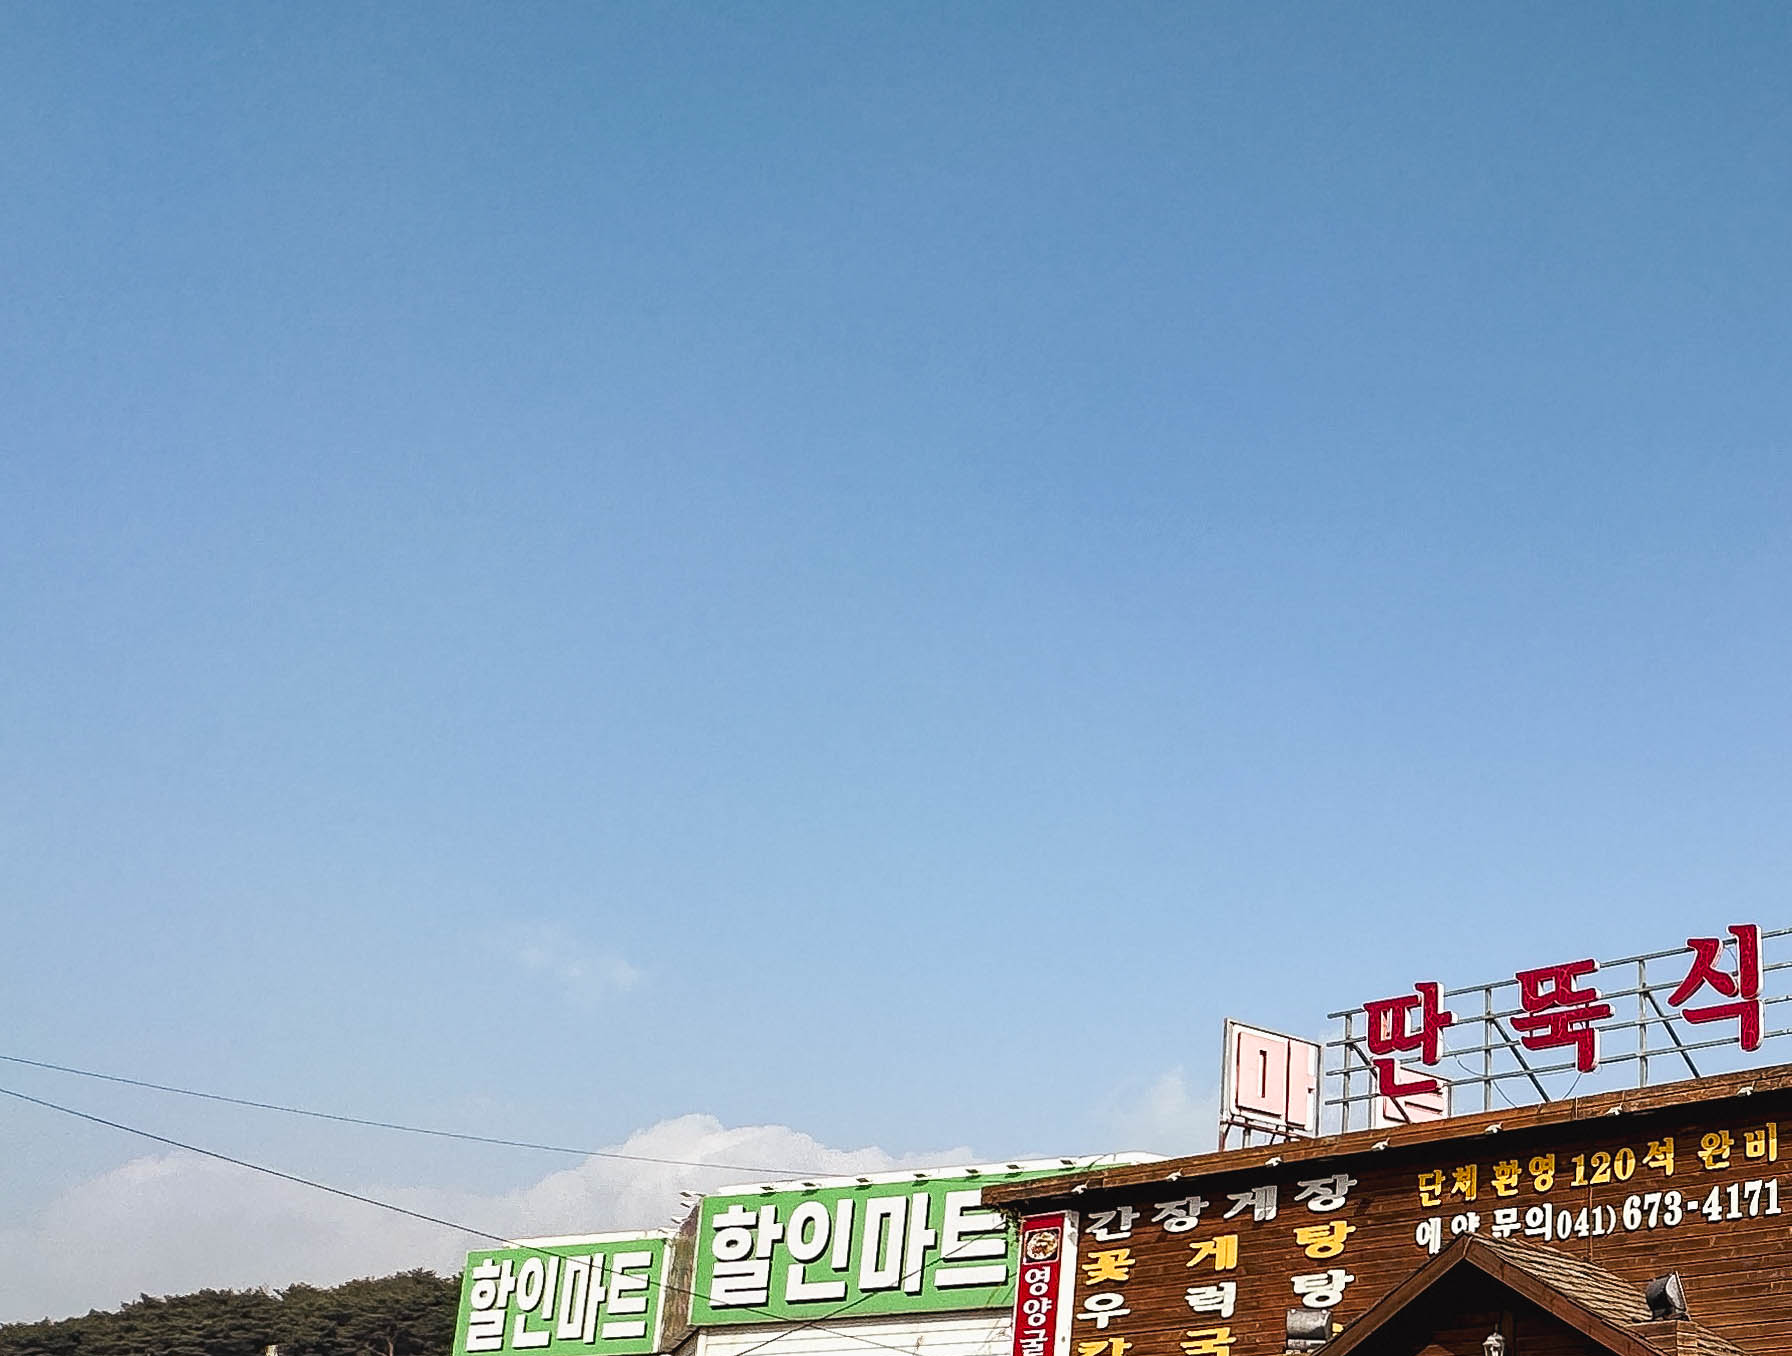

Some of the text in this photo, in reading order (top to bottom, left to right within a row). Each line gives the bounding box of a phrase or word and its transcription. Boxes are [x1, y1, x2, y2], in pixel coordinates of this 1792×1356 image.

[1085, 1173, 1357, 1242] 간장게장
[1417, 1164, 1478, 1207] 단체
[1493, 1153, 1556, 1198] 환영
[1697, 1122, 1779, 1170] 완비
[710, 1189, 1008, 1309] 할인마트
[466, 1251, 654, 1353] 할인마트
